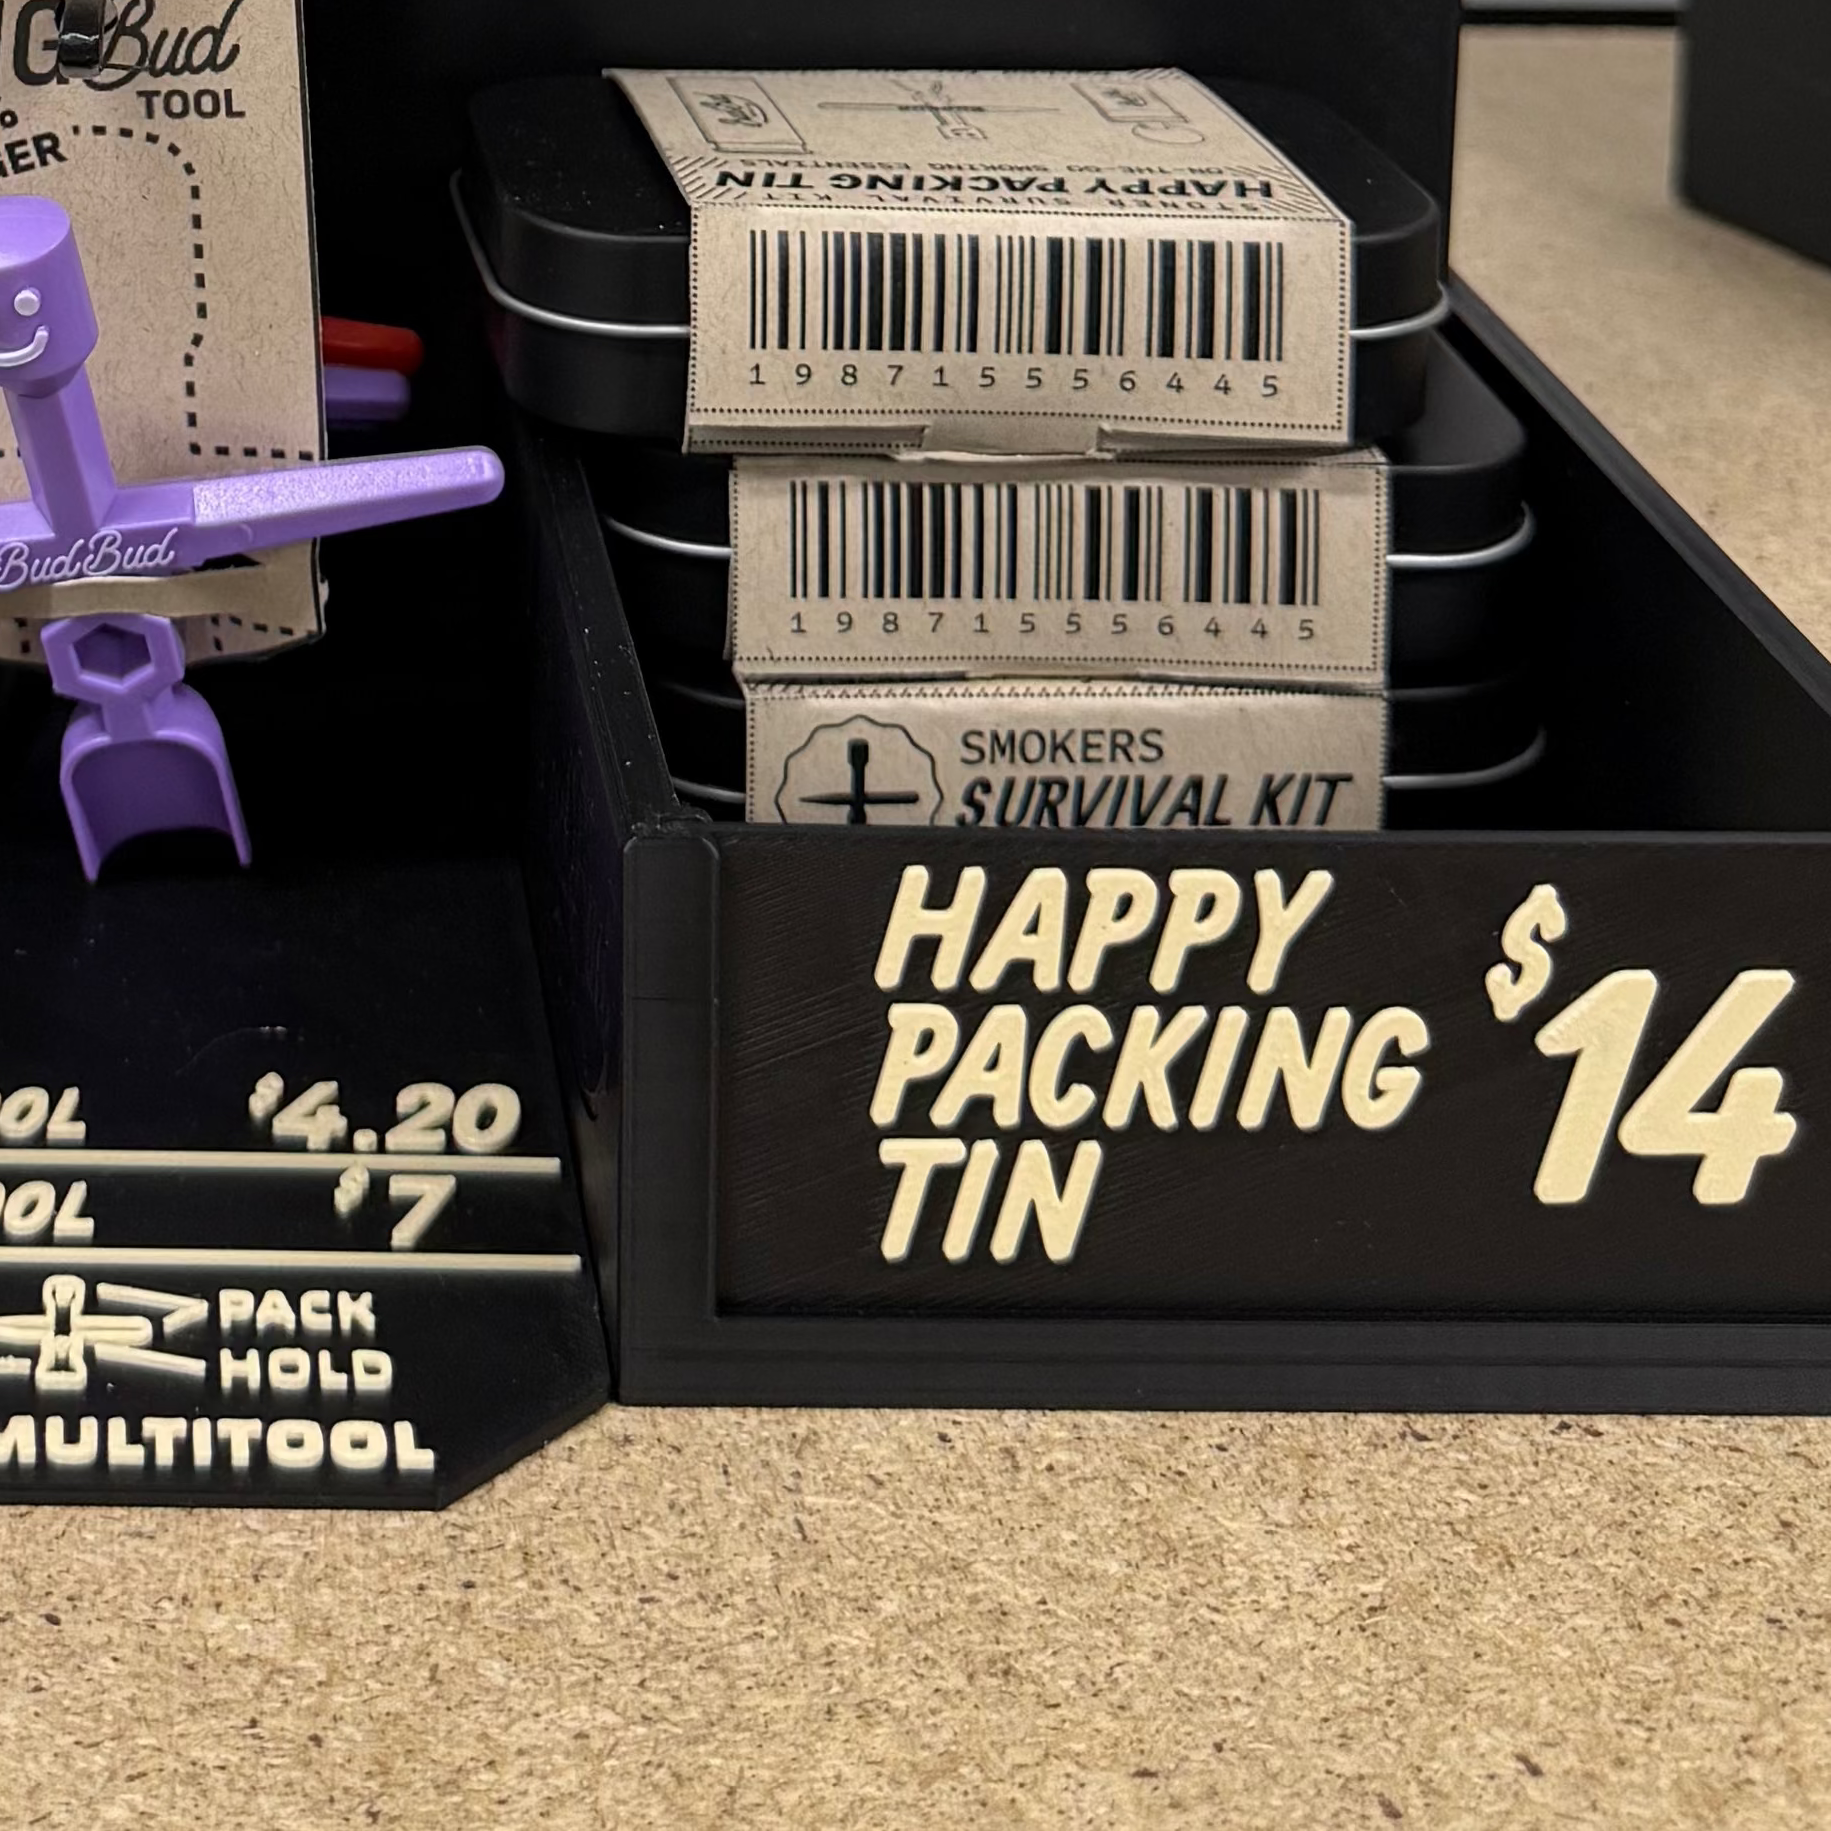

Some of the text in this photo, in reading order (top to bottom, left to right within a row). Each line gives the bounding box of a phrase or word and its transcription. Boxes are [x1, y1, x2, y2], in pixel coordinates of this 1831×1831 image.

[135, 88, 246, 120] TOOL
[715, 170, 1273, 198] HAPPY PACKING TIN
[739, 158, 911, 170] ESSENTIALS
[762, 192, 834, 202] KIT
[959, 727, 1165, 766] SMOKERS
[955, 771, 1354, 828] SURVIVAL KIT
[873, 863, 1335, 995] HAPPY
[867, 1001, 1432, 1133] PACKING
[1484, 881, 1799, 1207] $14
[247, 1069, 524, 1155] $4.20
[878, 1136, 1104, 1266] TIN
[217, 1287, 378, 1334] PACK
[217, 1345, 395, 1392] HOLD
